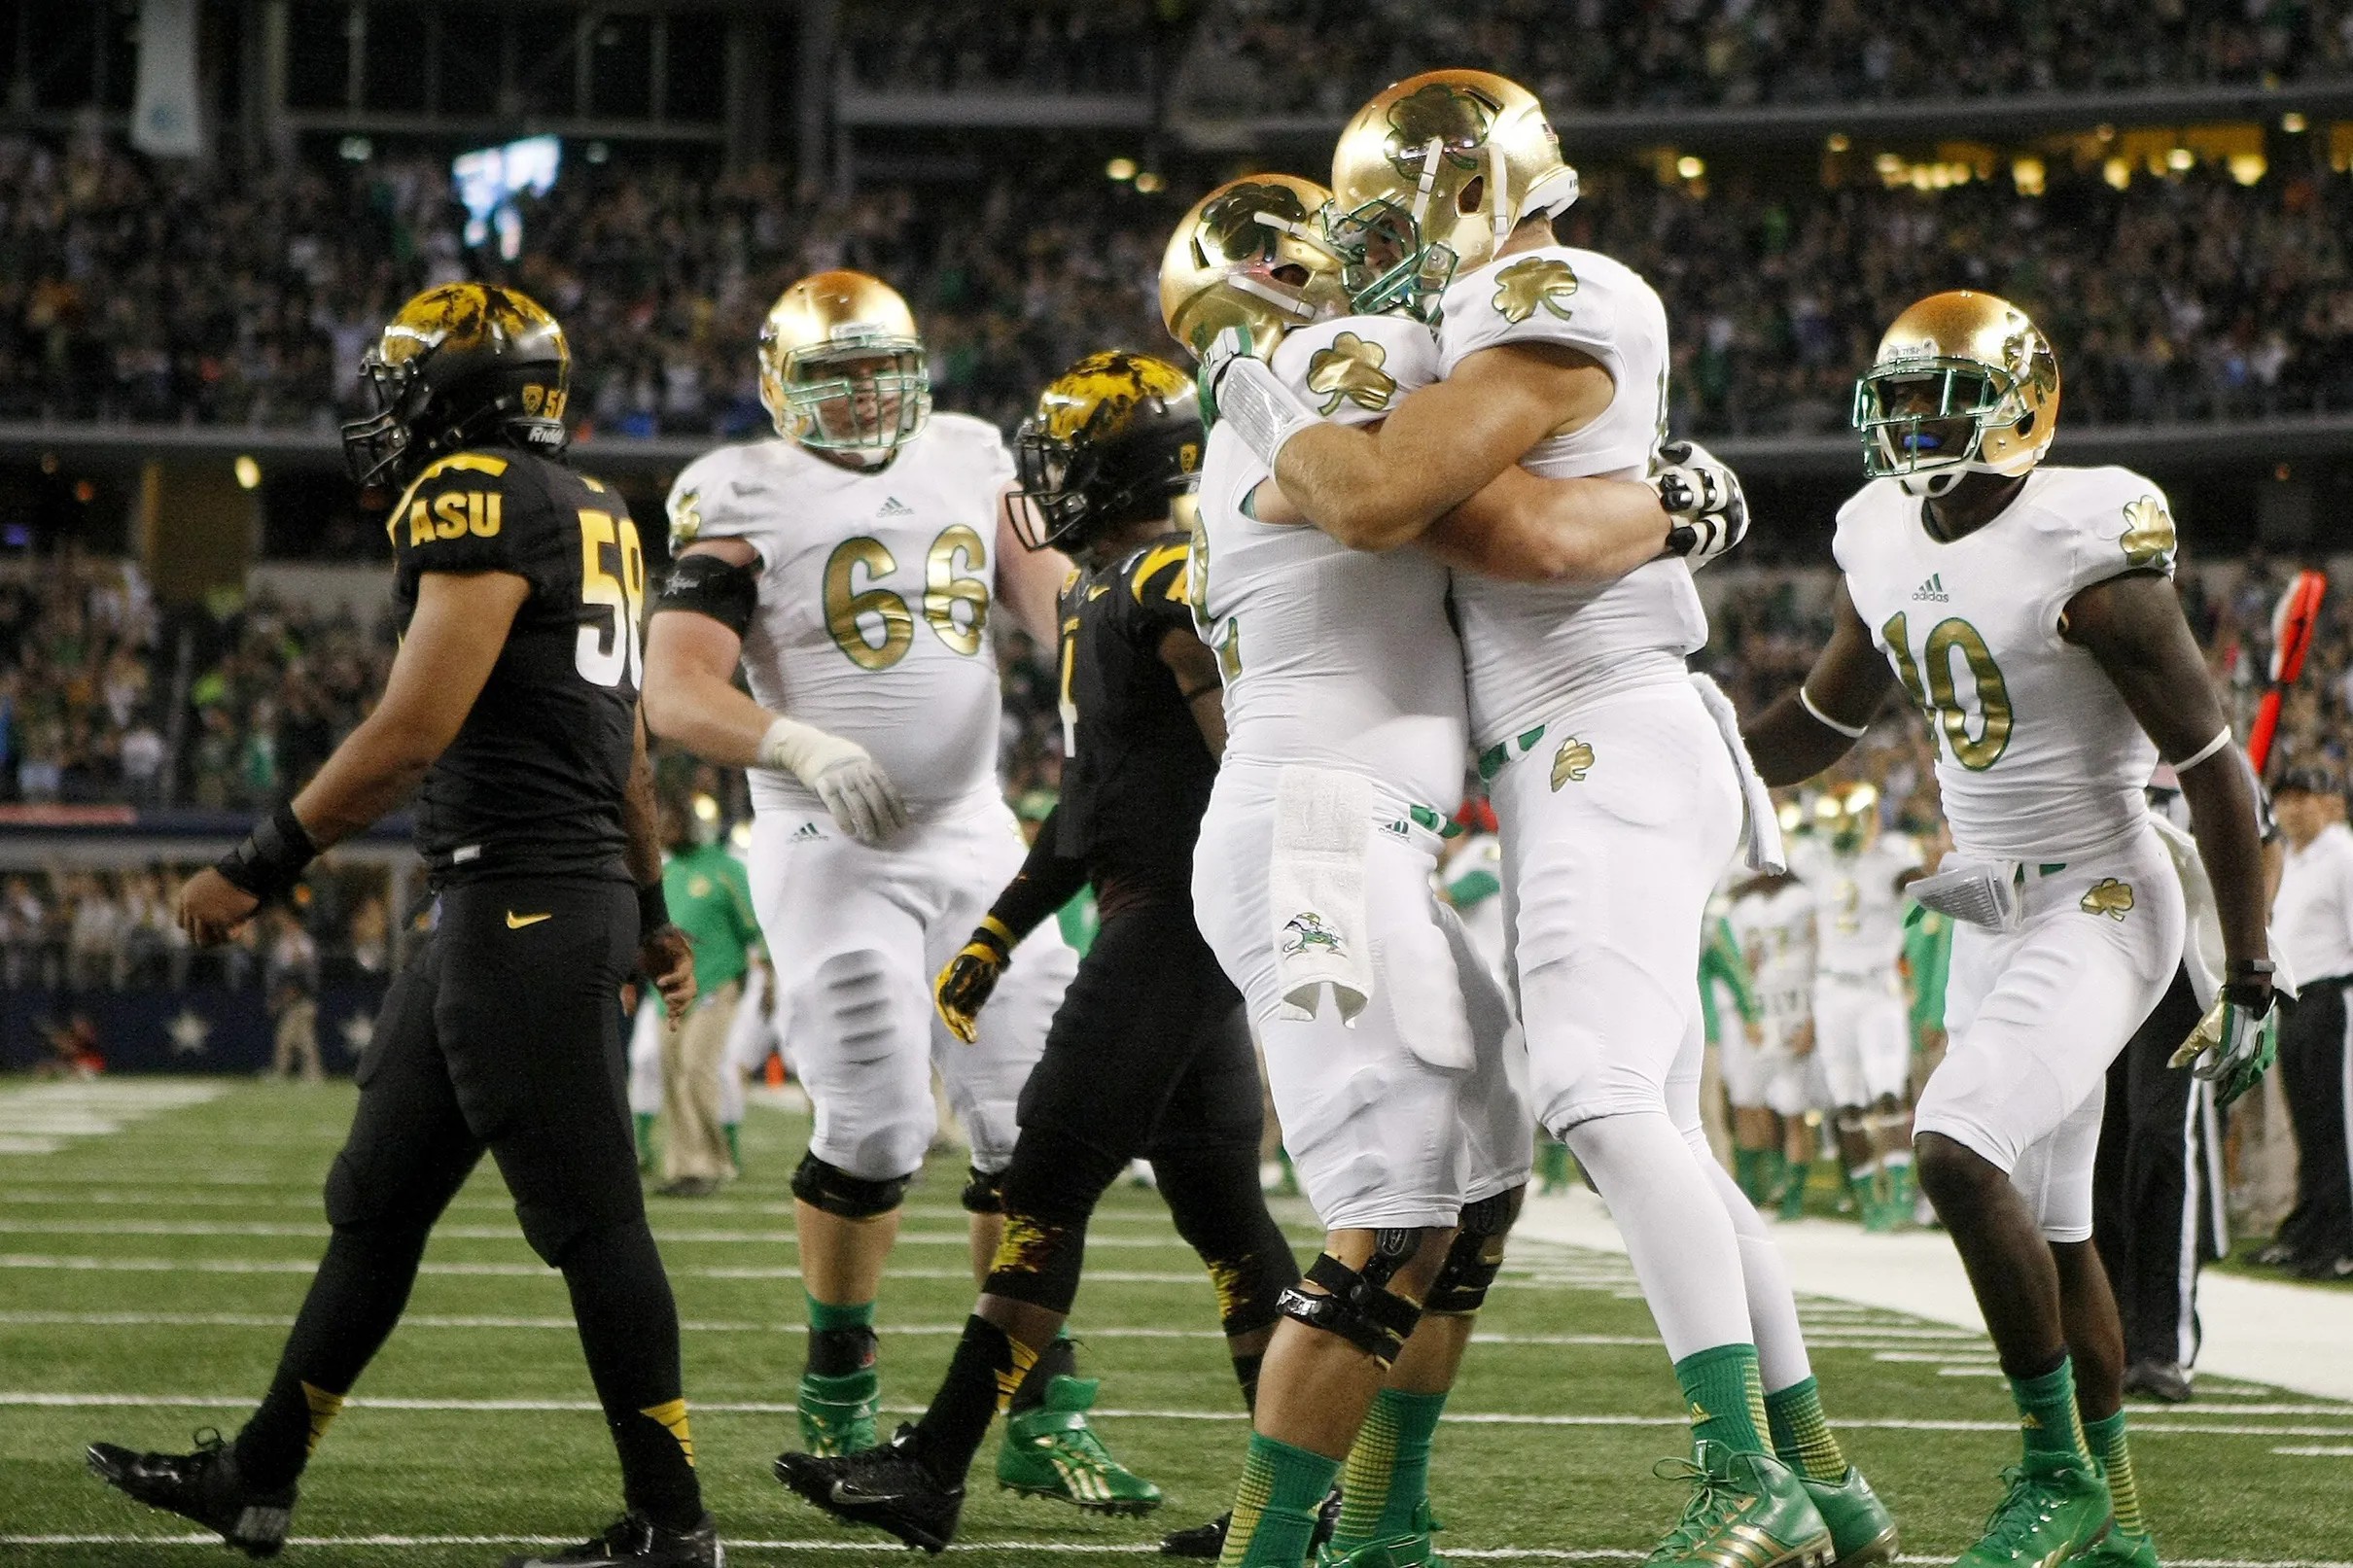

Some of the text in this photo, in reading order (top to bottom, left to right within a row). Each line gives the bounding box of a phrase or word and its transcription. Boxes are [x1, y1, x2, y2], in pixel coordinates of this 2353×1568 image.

[409, 492, 502, 547] ASU
[822, 523, 990, 671] 66
[1912, 588, 1949, 603] adidas
[1880, 610, 2014, 772] 10
